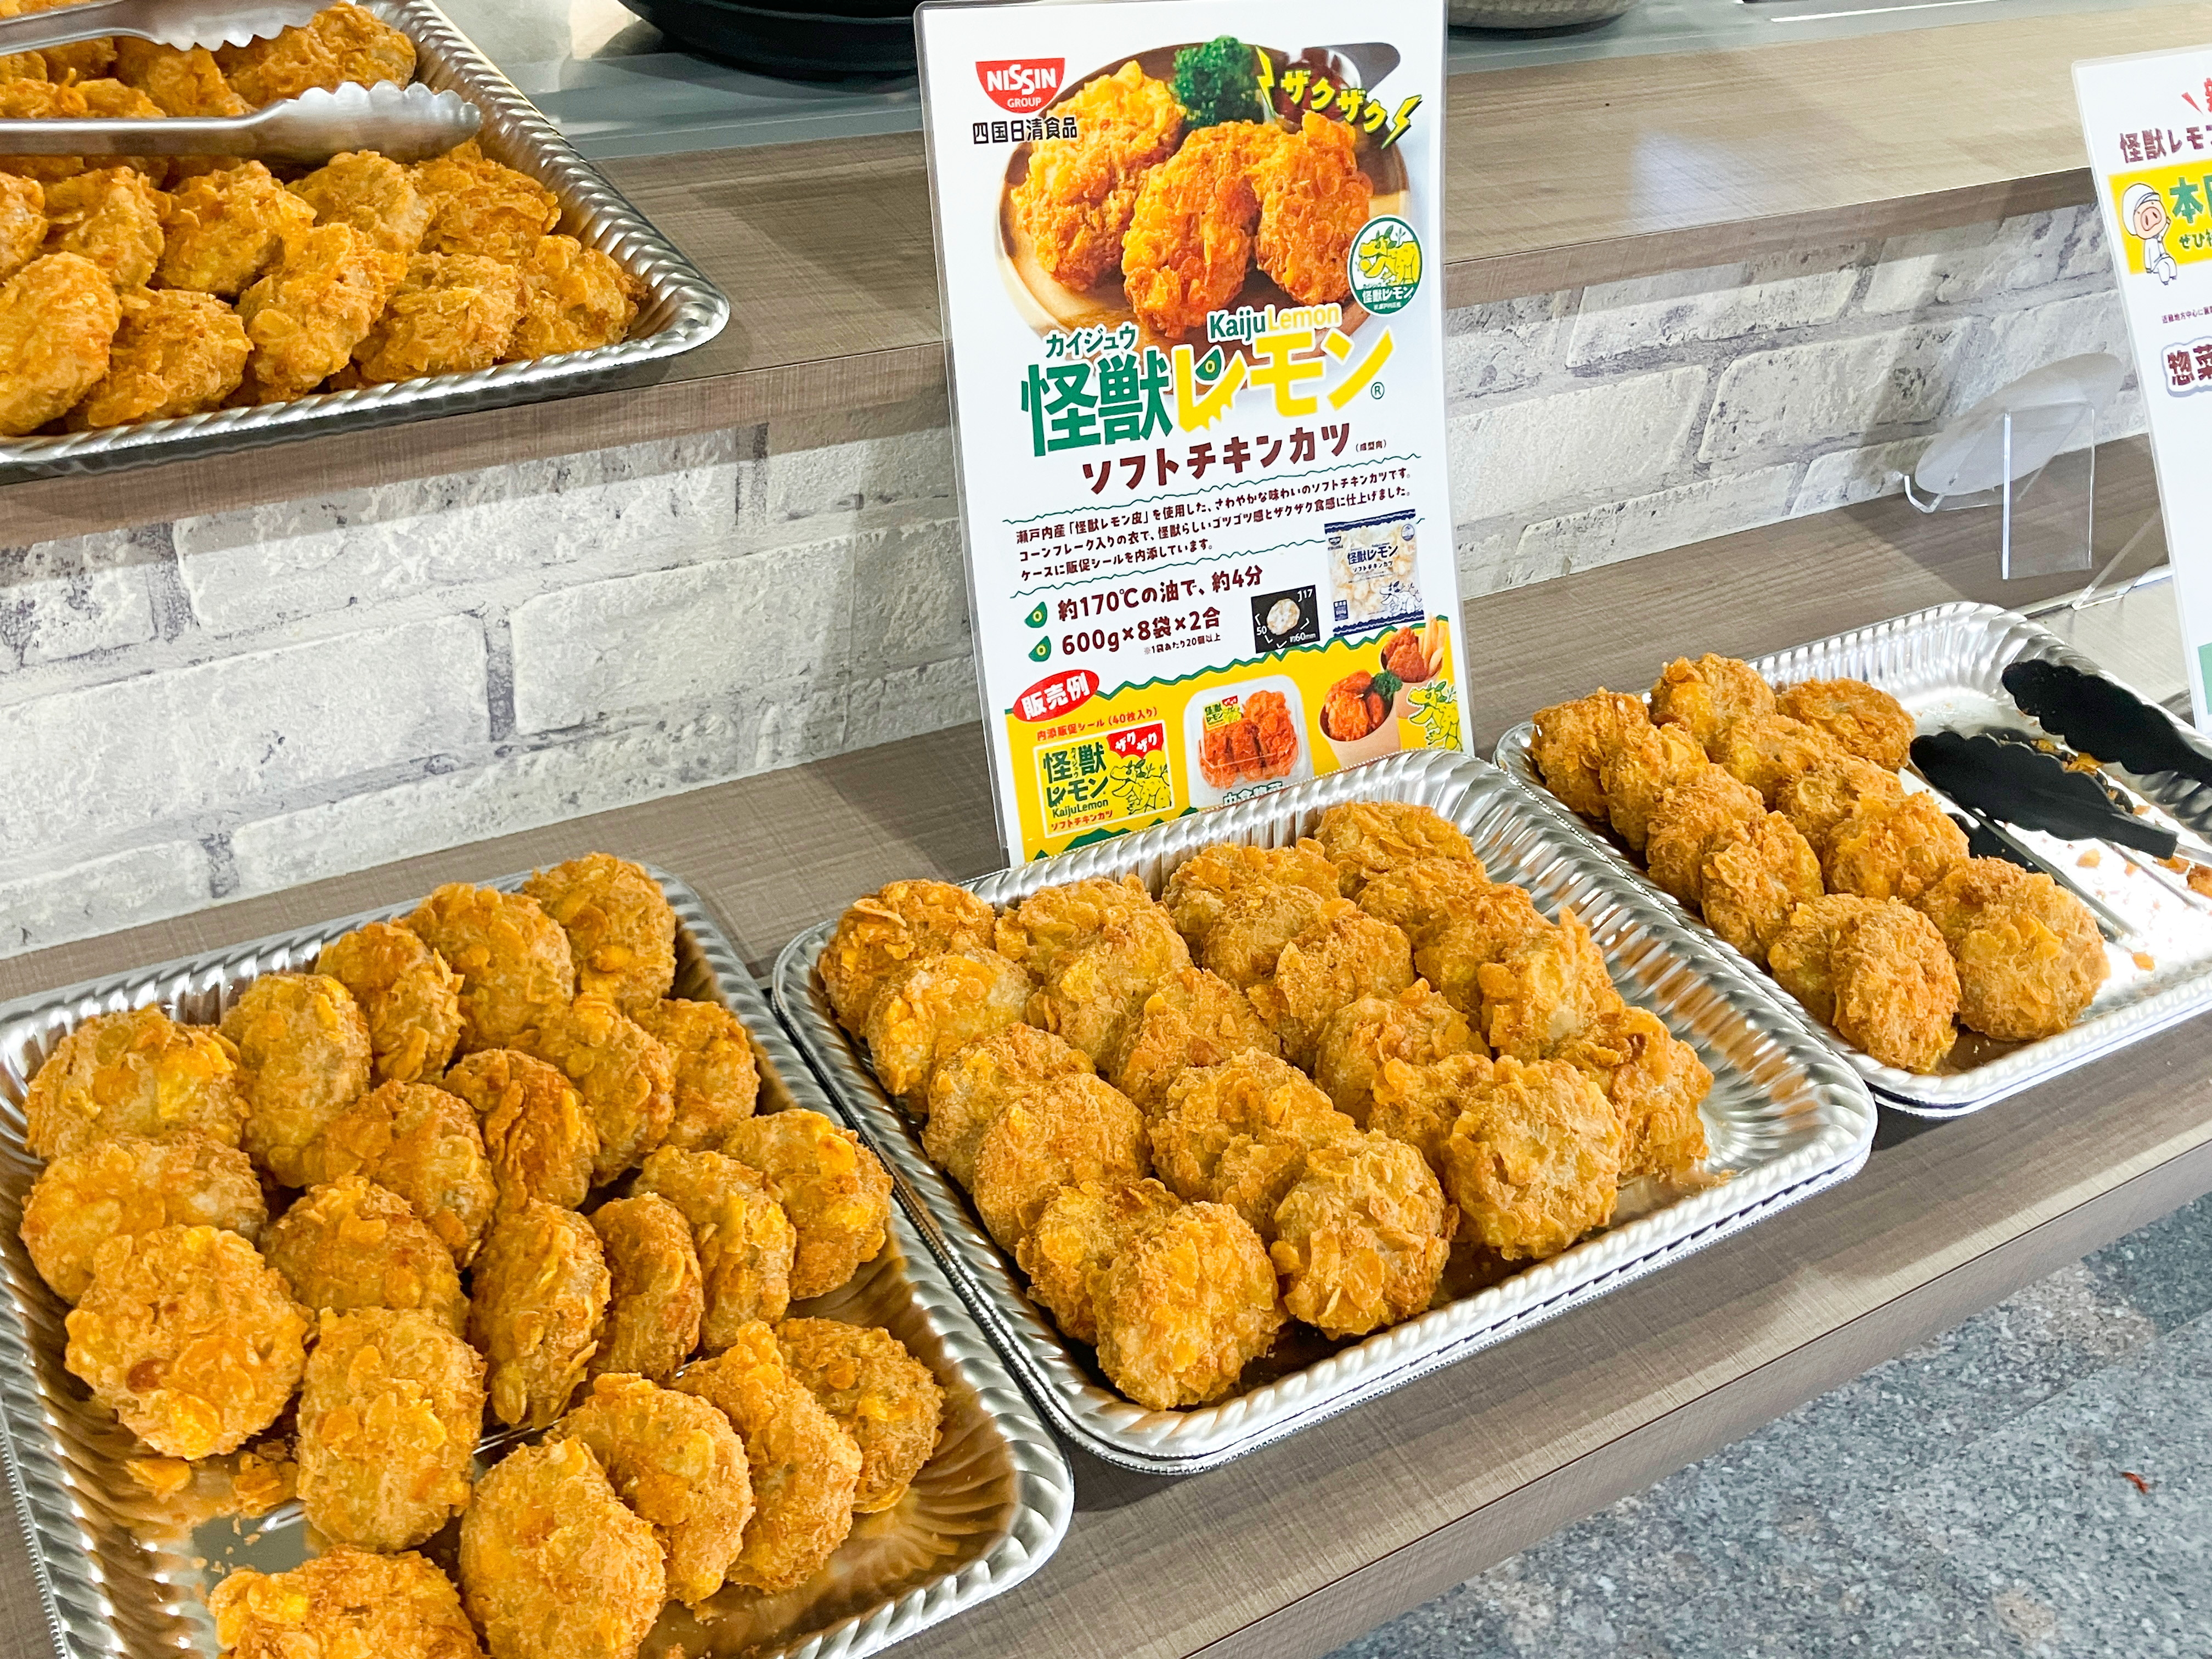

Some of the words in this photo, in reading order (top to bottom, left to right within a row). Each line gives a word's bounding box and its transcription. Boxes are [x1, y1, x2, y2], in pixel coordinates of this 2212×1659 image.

[987, 64, 1057, 95] NISSIN
[1007, 97, 1041, 108] GROUP
[1281, 69, 1387, 133] ザクザク
[973, 117, 1077, 144] 四国日清食品
[2120, 125, 2212, 163] 怪獣レモ
[1211, 307, 1339, 340] KaijuLemon
[1046, 325, 1137, 358] カイジュウ
[1082, 423, 1350, 494] ソフトチキンカツ
[1256, 626, 1267, 635] 50
[1022, 672, 1090, 719] 販売例
[1115, 732, 1157, 752] ザクザク
[1043, 742, 1107, 783] 怪獣
[1047, 776, 1108, 808] レモン
[1052, 810, 1113, 831] ソフトチキンカツ
[1053, 799, 1108, 818] KaijuLemon
